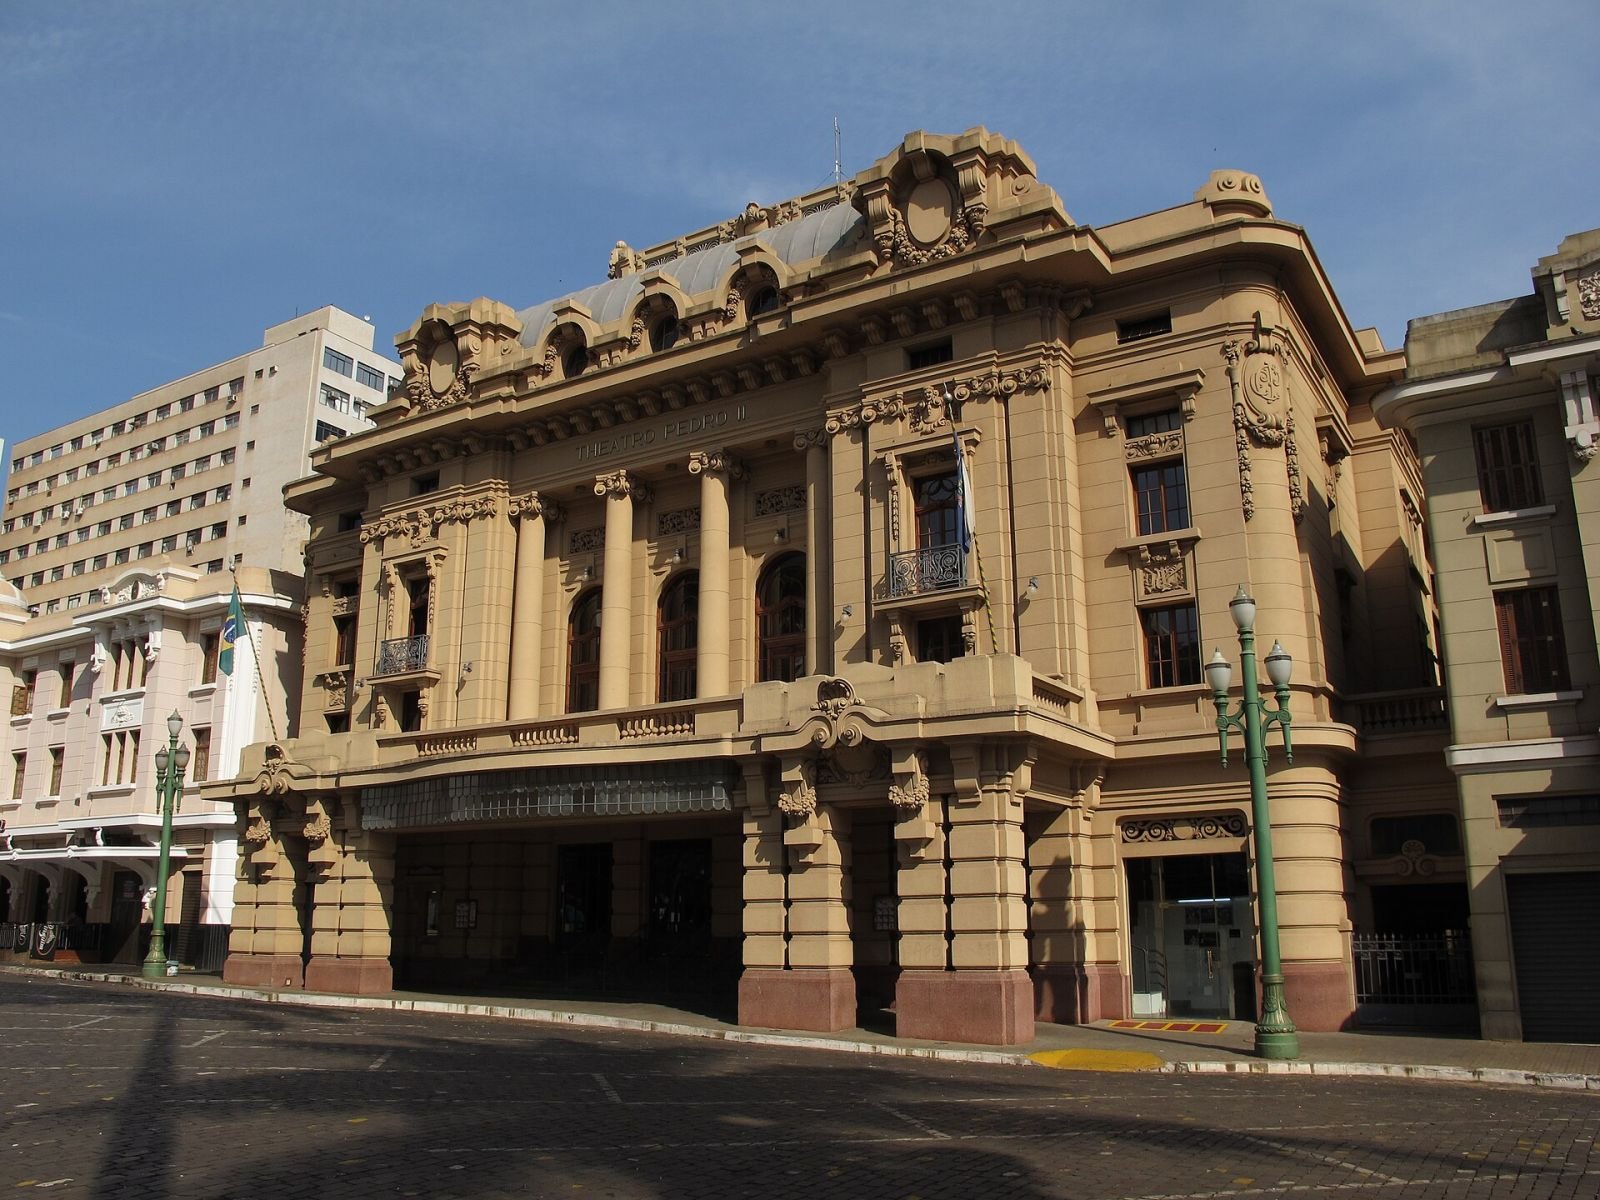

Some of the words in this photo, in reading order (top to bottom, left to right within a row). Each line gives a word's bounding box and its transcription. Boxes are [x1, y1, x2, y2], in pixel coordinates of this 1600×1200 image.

[576, 429, 656, 461] THEATRO
[664, 410, 728, 440] PEDRO
[737, 405, 747, 422] II
